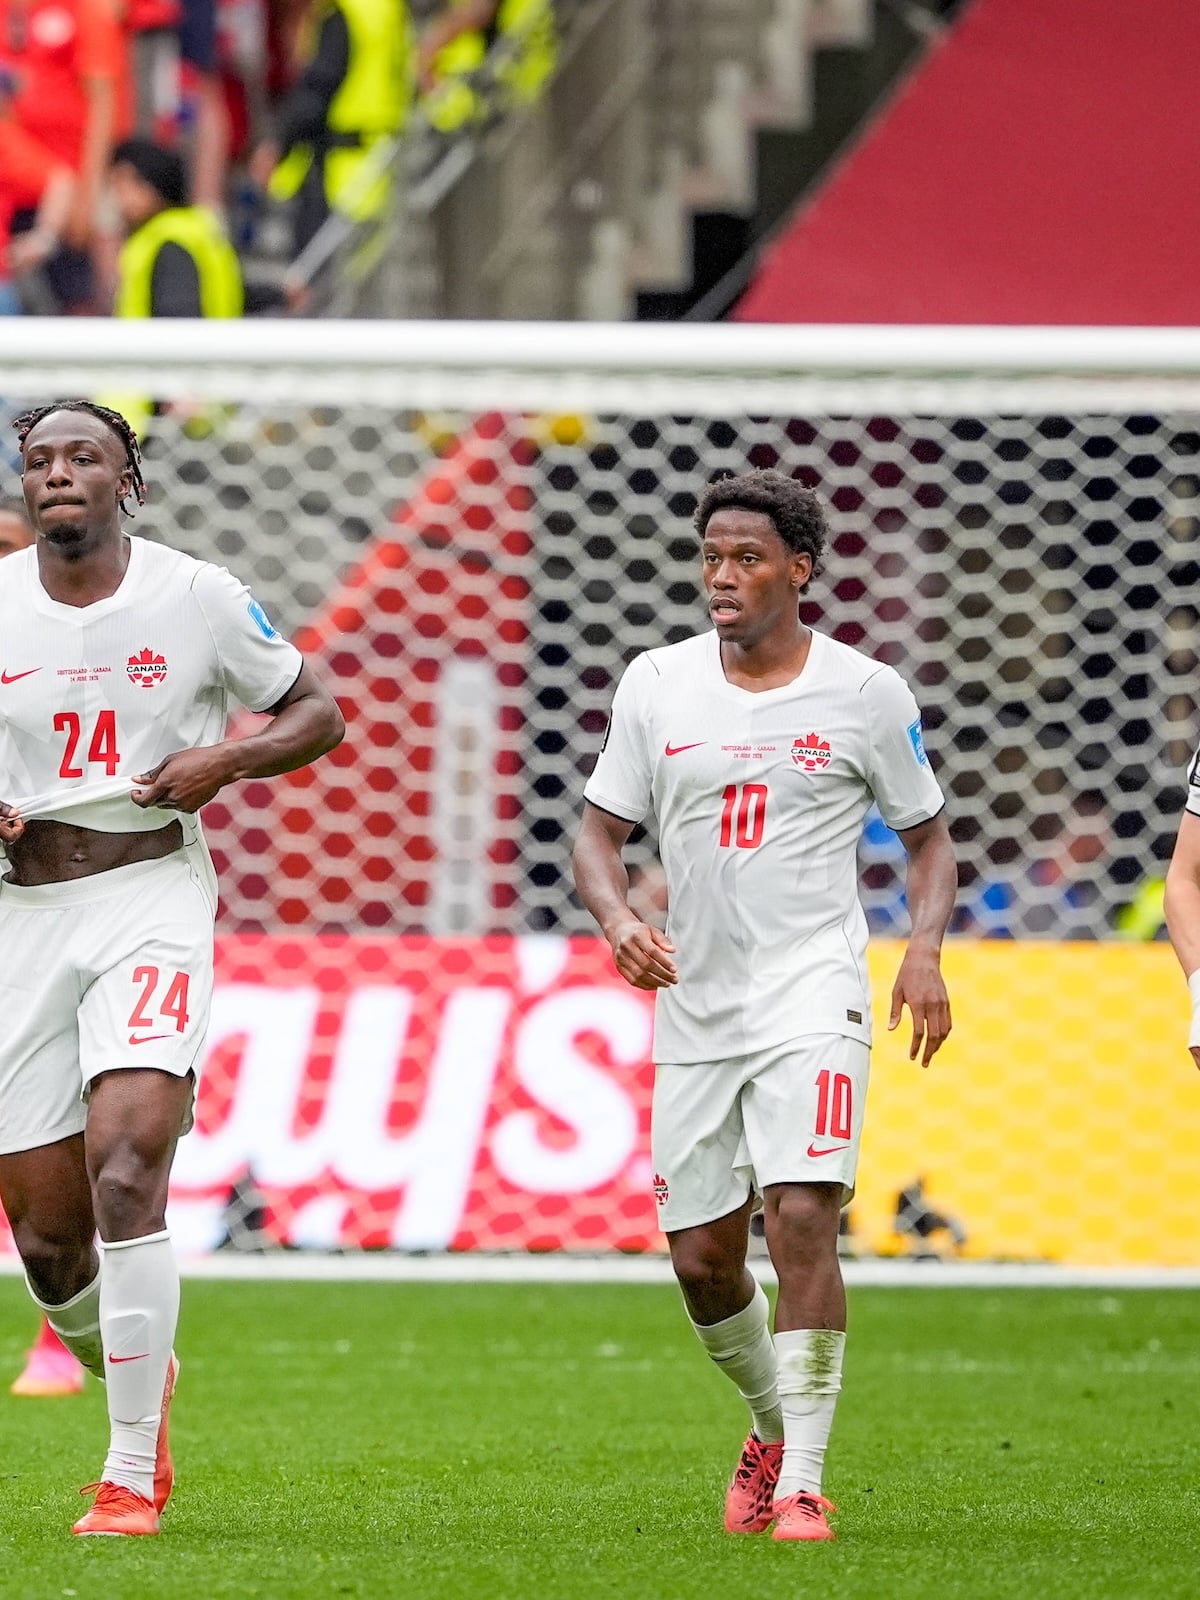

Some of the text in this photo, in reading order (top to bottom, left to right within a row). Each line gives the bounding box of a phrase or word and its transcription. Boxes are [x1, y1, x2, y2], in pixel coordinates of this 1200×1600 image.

[126, 665, 168, 673] CANADA
[53, 709, 121, 778] 24
[790, 748, 832, 758] CANADA
[719, 784, 768, 849] 10
[127, 965, 190, 1033] 24
[170, 936, 654, 1250] ay's
[815, 1069, 852, 1140] 10
